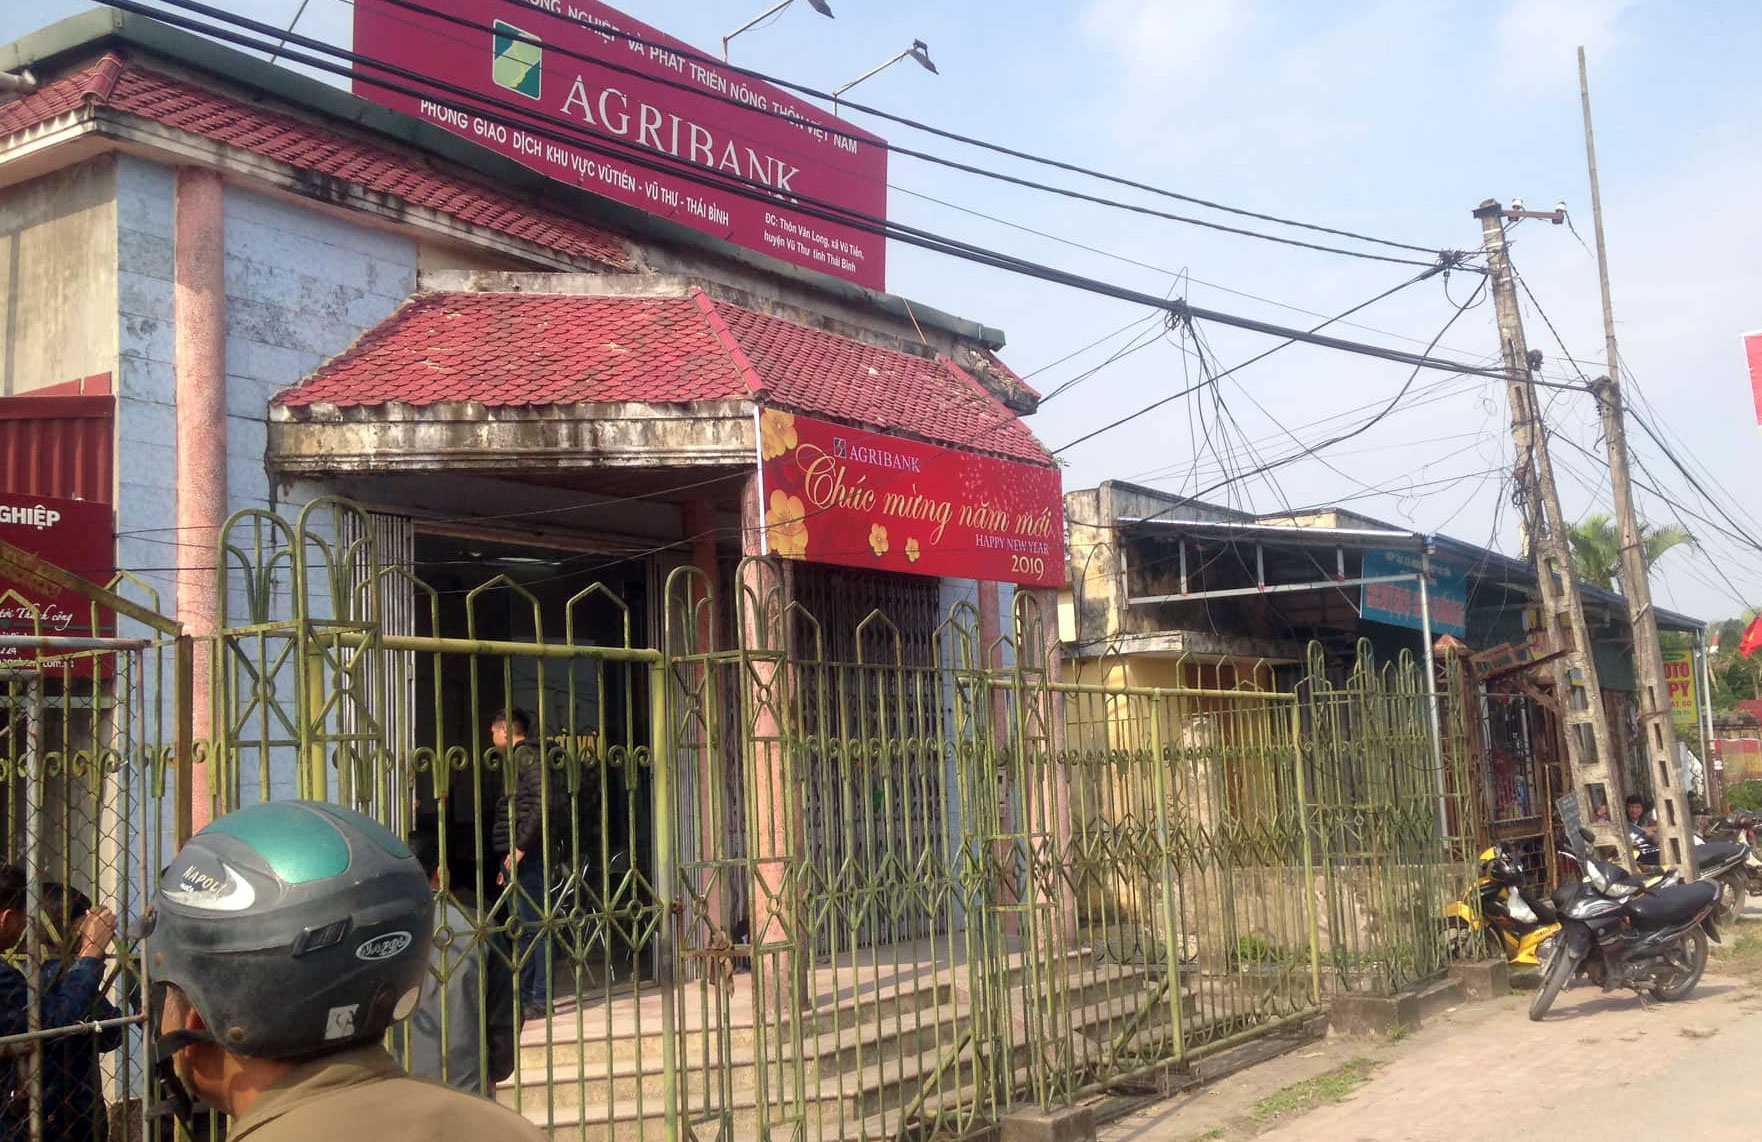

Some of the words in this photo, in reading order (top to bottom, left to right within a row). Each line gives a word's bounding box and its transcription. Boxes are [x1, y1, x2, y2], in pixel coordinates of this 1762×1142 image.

[559, 74, 800, 204] AGRIBANK
[730, 82, 767, 110] NÔNG
[833, 134, 857, 155] NAM
[473, 117, 507, 143] GIAO
[513, 131, 542, 157] DỊCH
[546, 144, 568, 167] KHU
[571, 153, 595, 177] VỰC
[645, 180, 659, 200] VŨ
[661, 187, 679, 207] THƯ
[686, 196, 706, 218] THÁI
[708, 202, 729, 226] BÌNH
[795, 443, 877, 512] Chúc
[882, 483, 953, 546] mừng
[958, 500, 1010, 533] năm
[1014, 506, 1053, 539] mới
[849, 445, 920, 473] AGRIBANK
[975, 533, 1004, 549] HAPPY
[1006, 538, 1027, 552] NEW
[1027, 541, 1049, 555] YEAR
[1011, 554, 1044, 580] 2019
